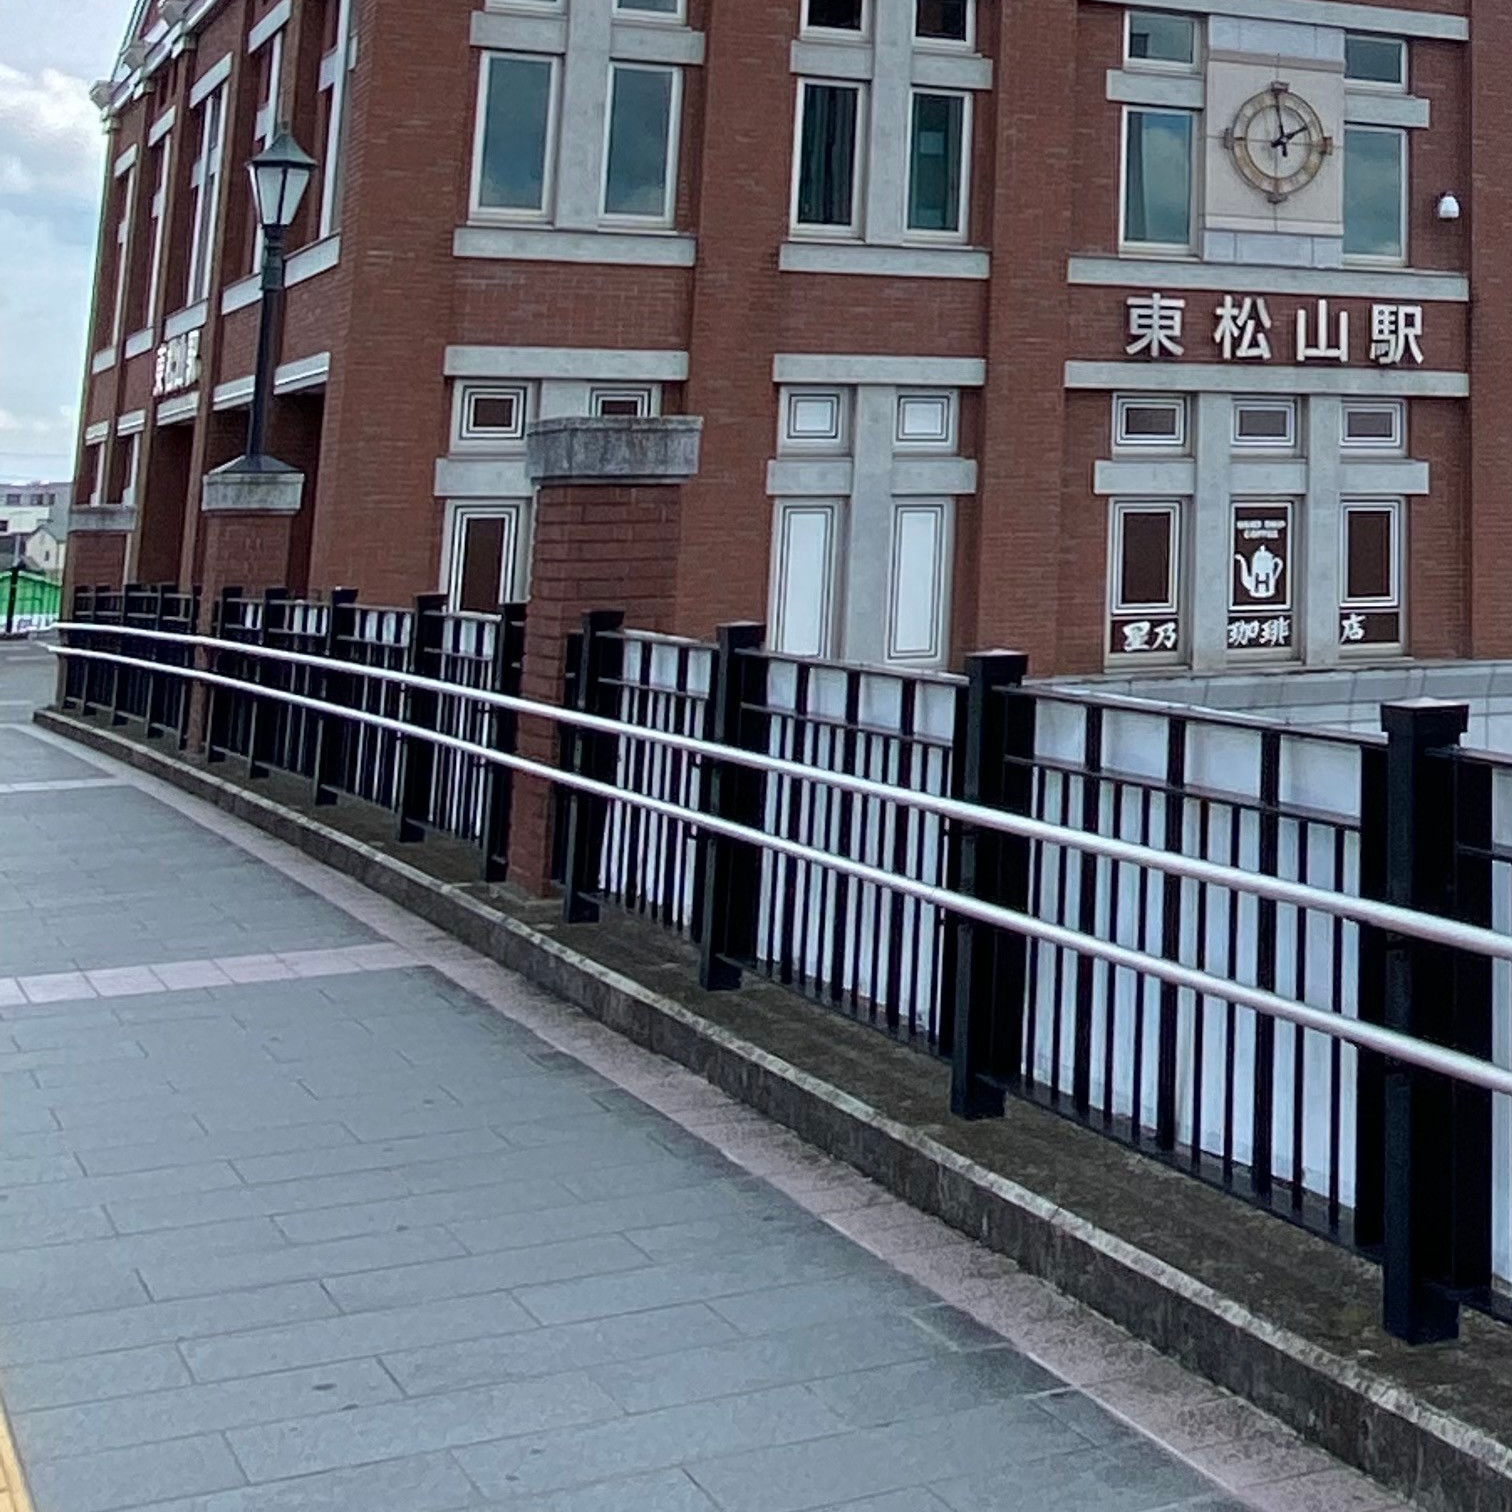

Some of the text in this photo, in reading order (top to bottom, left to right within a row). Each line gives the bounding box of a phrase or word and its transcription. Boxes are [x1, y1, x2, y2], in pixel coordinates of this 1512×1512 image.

[1125, 292, 1425, 365] 東松山駅
[1254, 572, 1271, 593] H
